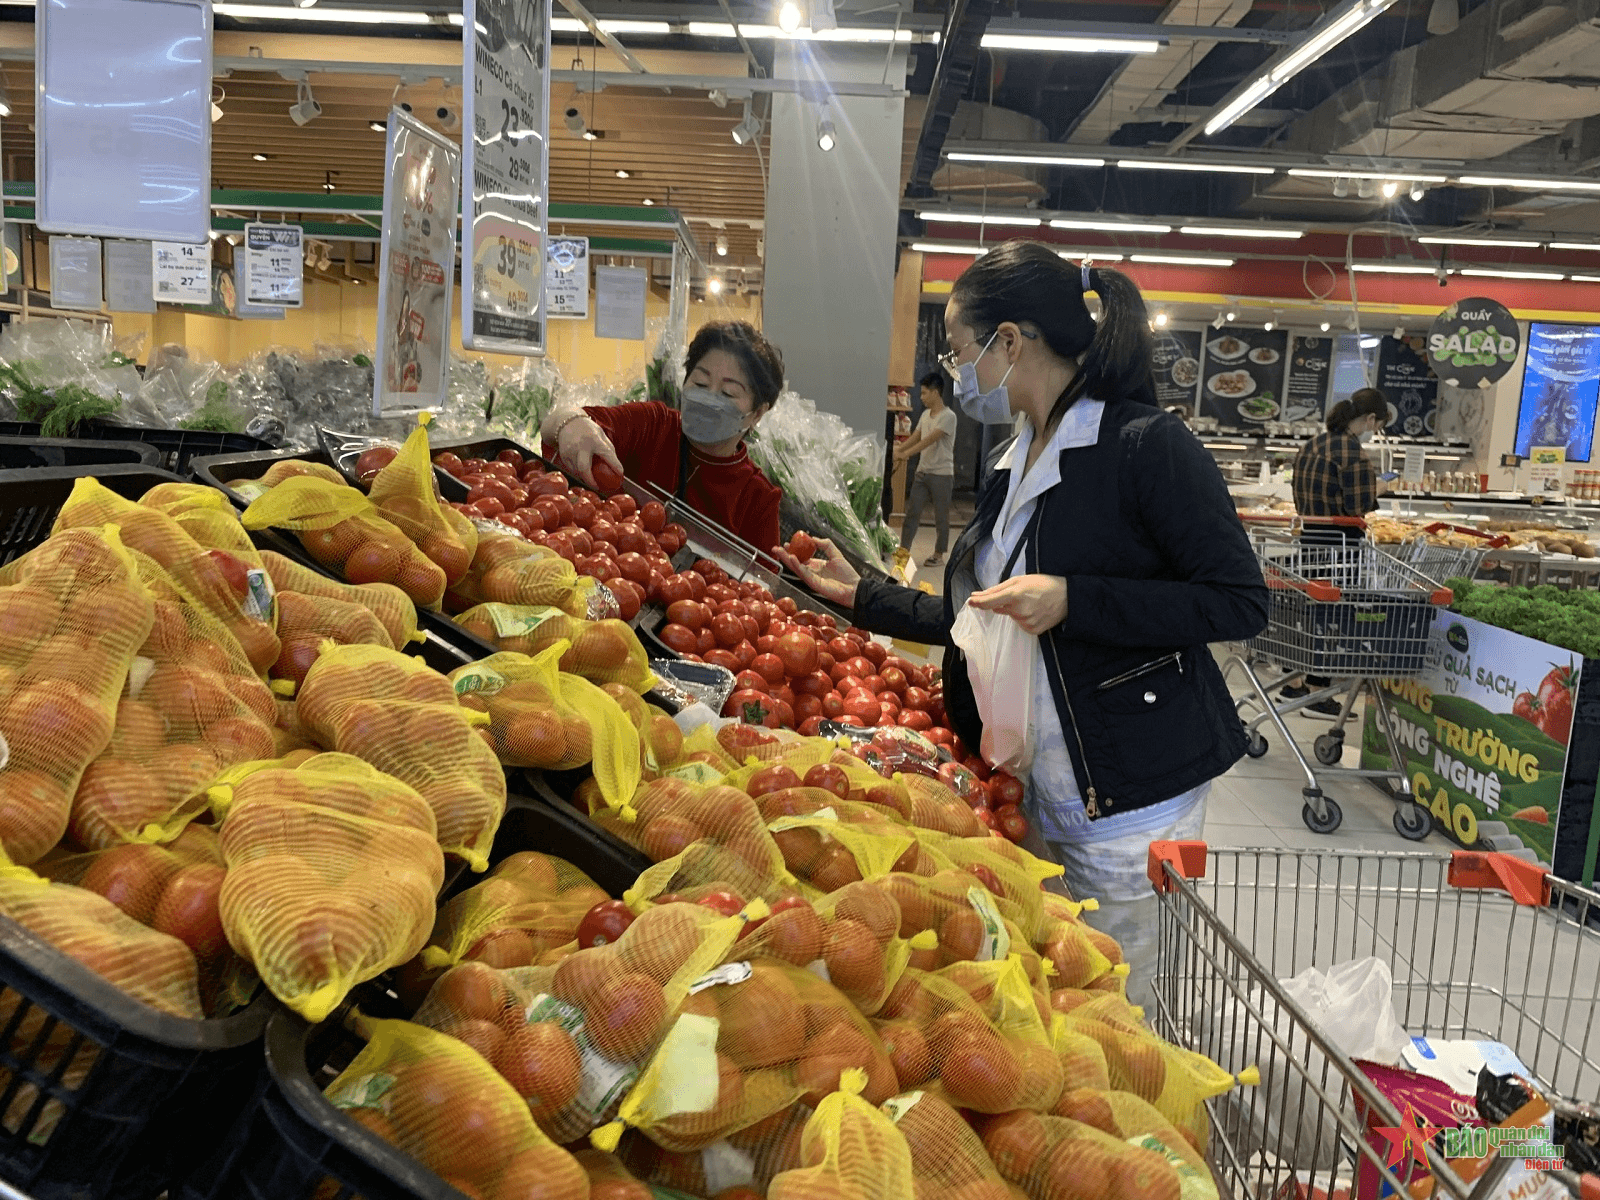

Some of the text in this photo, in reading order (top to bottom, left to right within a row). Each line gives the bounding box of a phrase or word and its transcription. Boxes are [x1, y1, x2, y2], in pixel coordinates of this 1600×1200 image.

[475, 43, 503, 83] WINECO
[501, 98, 520, 148] 23
[509, 156, 519, 180] 29
[181, 247, 193, 256] 14
[497, 235, 517, 279] 39
[180, 277, 194, 286] 27
[554, 295, 566, 305] 15
[1429, 333, 1517, 355] SALAD
[1443, 653, 1472, 681] QUẢ
[1475, 666, 1518, 700] SẠCH
[1444, 675, 1461, 694] TỪ
[1433, 715, 1540, 784] TRƯỜNG
[1433, 749, 1501, 815] NGHỆ
[1412, 771, 1479, 845] CAO
